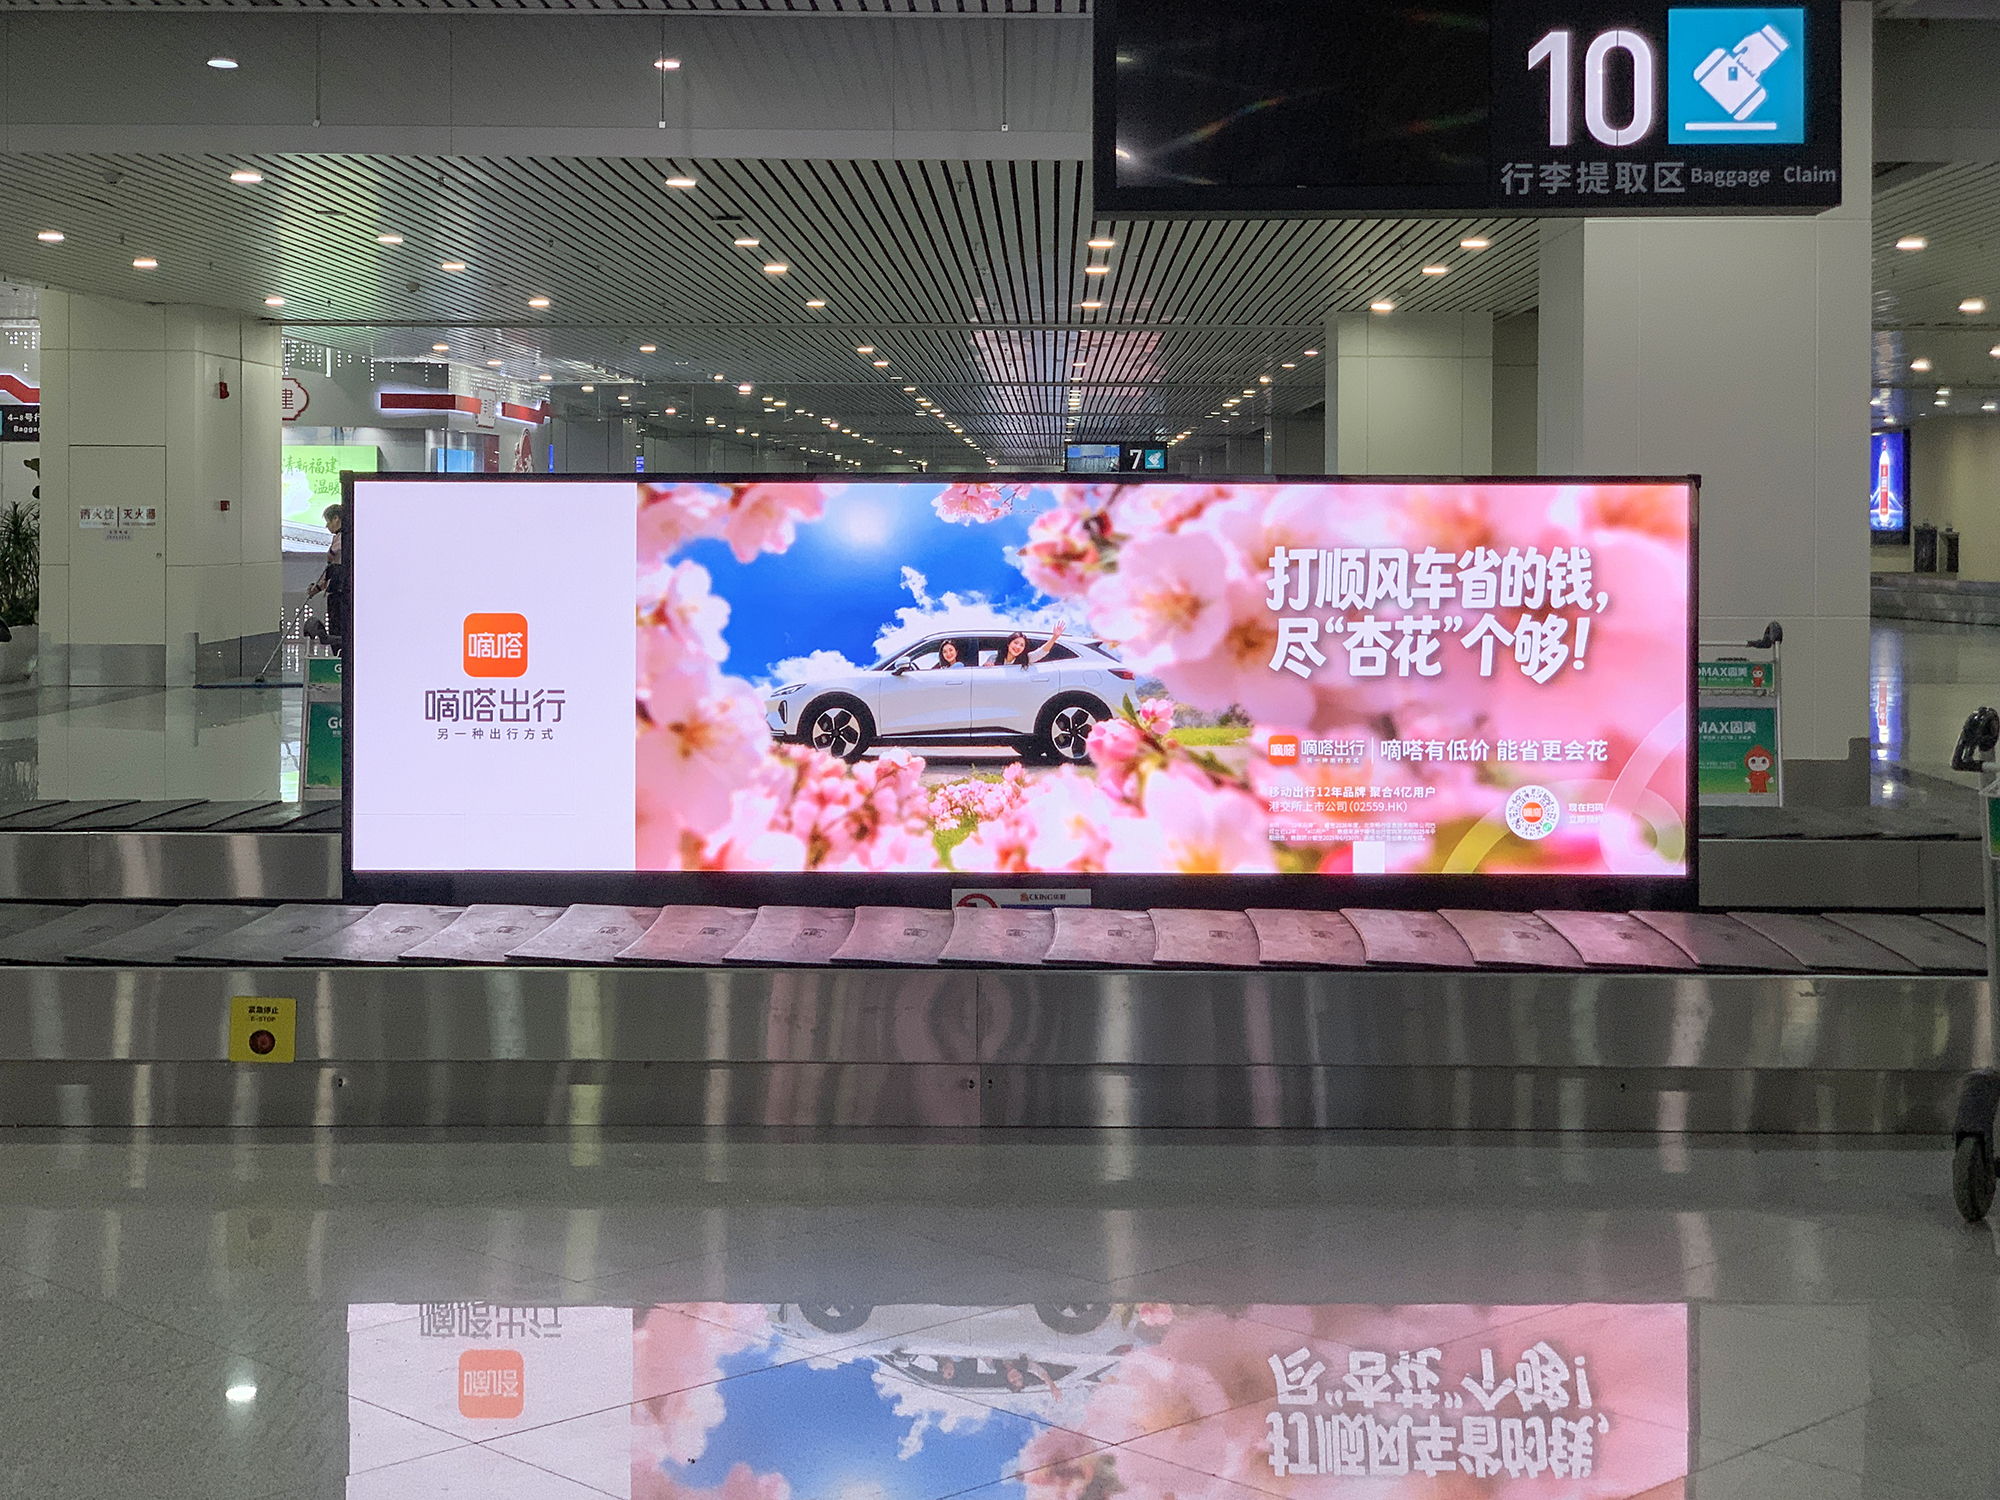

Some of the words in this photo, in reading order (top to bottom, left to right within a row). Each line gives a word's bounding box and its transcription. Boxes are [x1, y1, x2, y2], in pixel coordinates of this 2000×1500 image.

[1527, 28, 1655, 147] 10
[1500, 160, 1686, 196] 行李提取区
[1690, 165, 1771, 187] Baggage
[1783, 164, 1838, 184] Claim
[281, 455, 340, 476] 清新福建
[1129, 448, 1143, 470] 7
[122, 507, 156, 520] 灭火器
[467, 631, 524, 660] 嘀嗒
[424, 687, 566, 724] 嘀嗒出行
[436, 727, 555, 742] 另一种出行方式
[1270, 743, 1296, 757] 嘀嗒
[1300, 739, 1365, 757] 嘀嗒出行
[1380, 738, 1490, 762] 嘀嗒有低价
[1496, 738, 1609, 762] 能省更会花
[1268, 785, 1367, 799] 移动出行12年品牌
[1369, 785, 1437, 799] 聚合4亿用户
[1568, 802, 1604, 813] 现在扫码
[247, 1005, 279, 1015] 紧急停止
